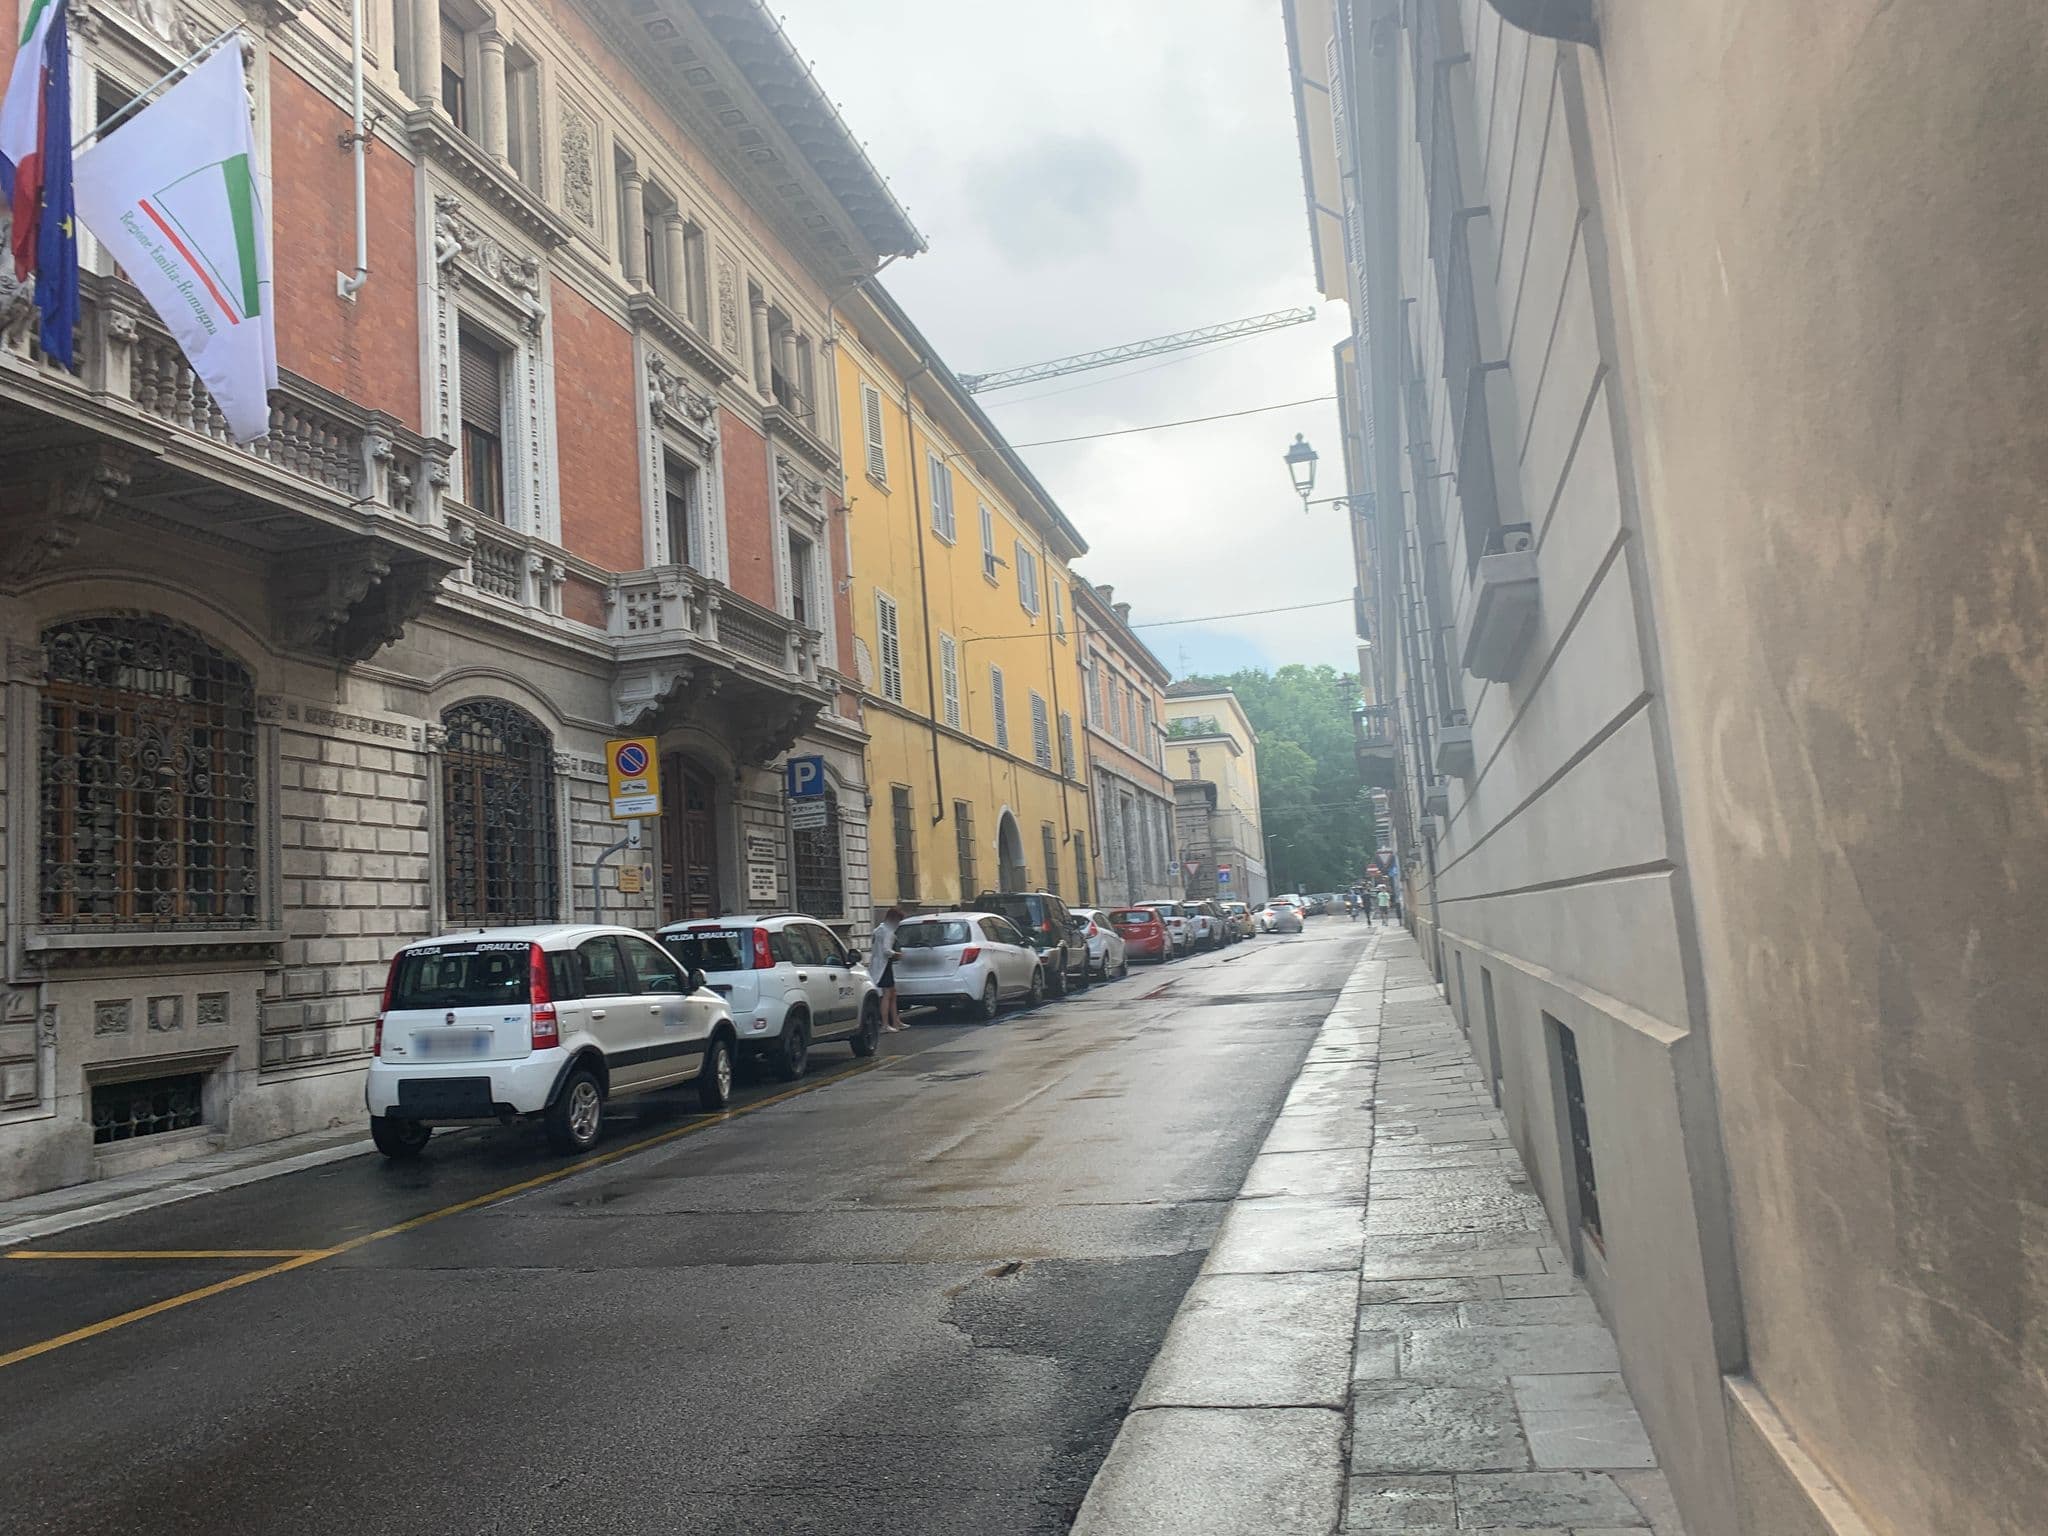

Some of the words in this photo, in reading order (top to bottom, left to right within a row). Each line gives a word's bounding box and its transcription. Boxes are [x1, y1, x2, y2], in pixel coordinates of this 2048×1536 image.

[120, 210, 152, 249] Regione
[150, 244, 217, 336] Emilia-Romagna
[794, 762, 817, 793] P
[405, 947, 440, 957] POLIZIA
[476, 943, 530, 952] IDRAULICA
